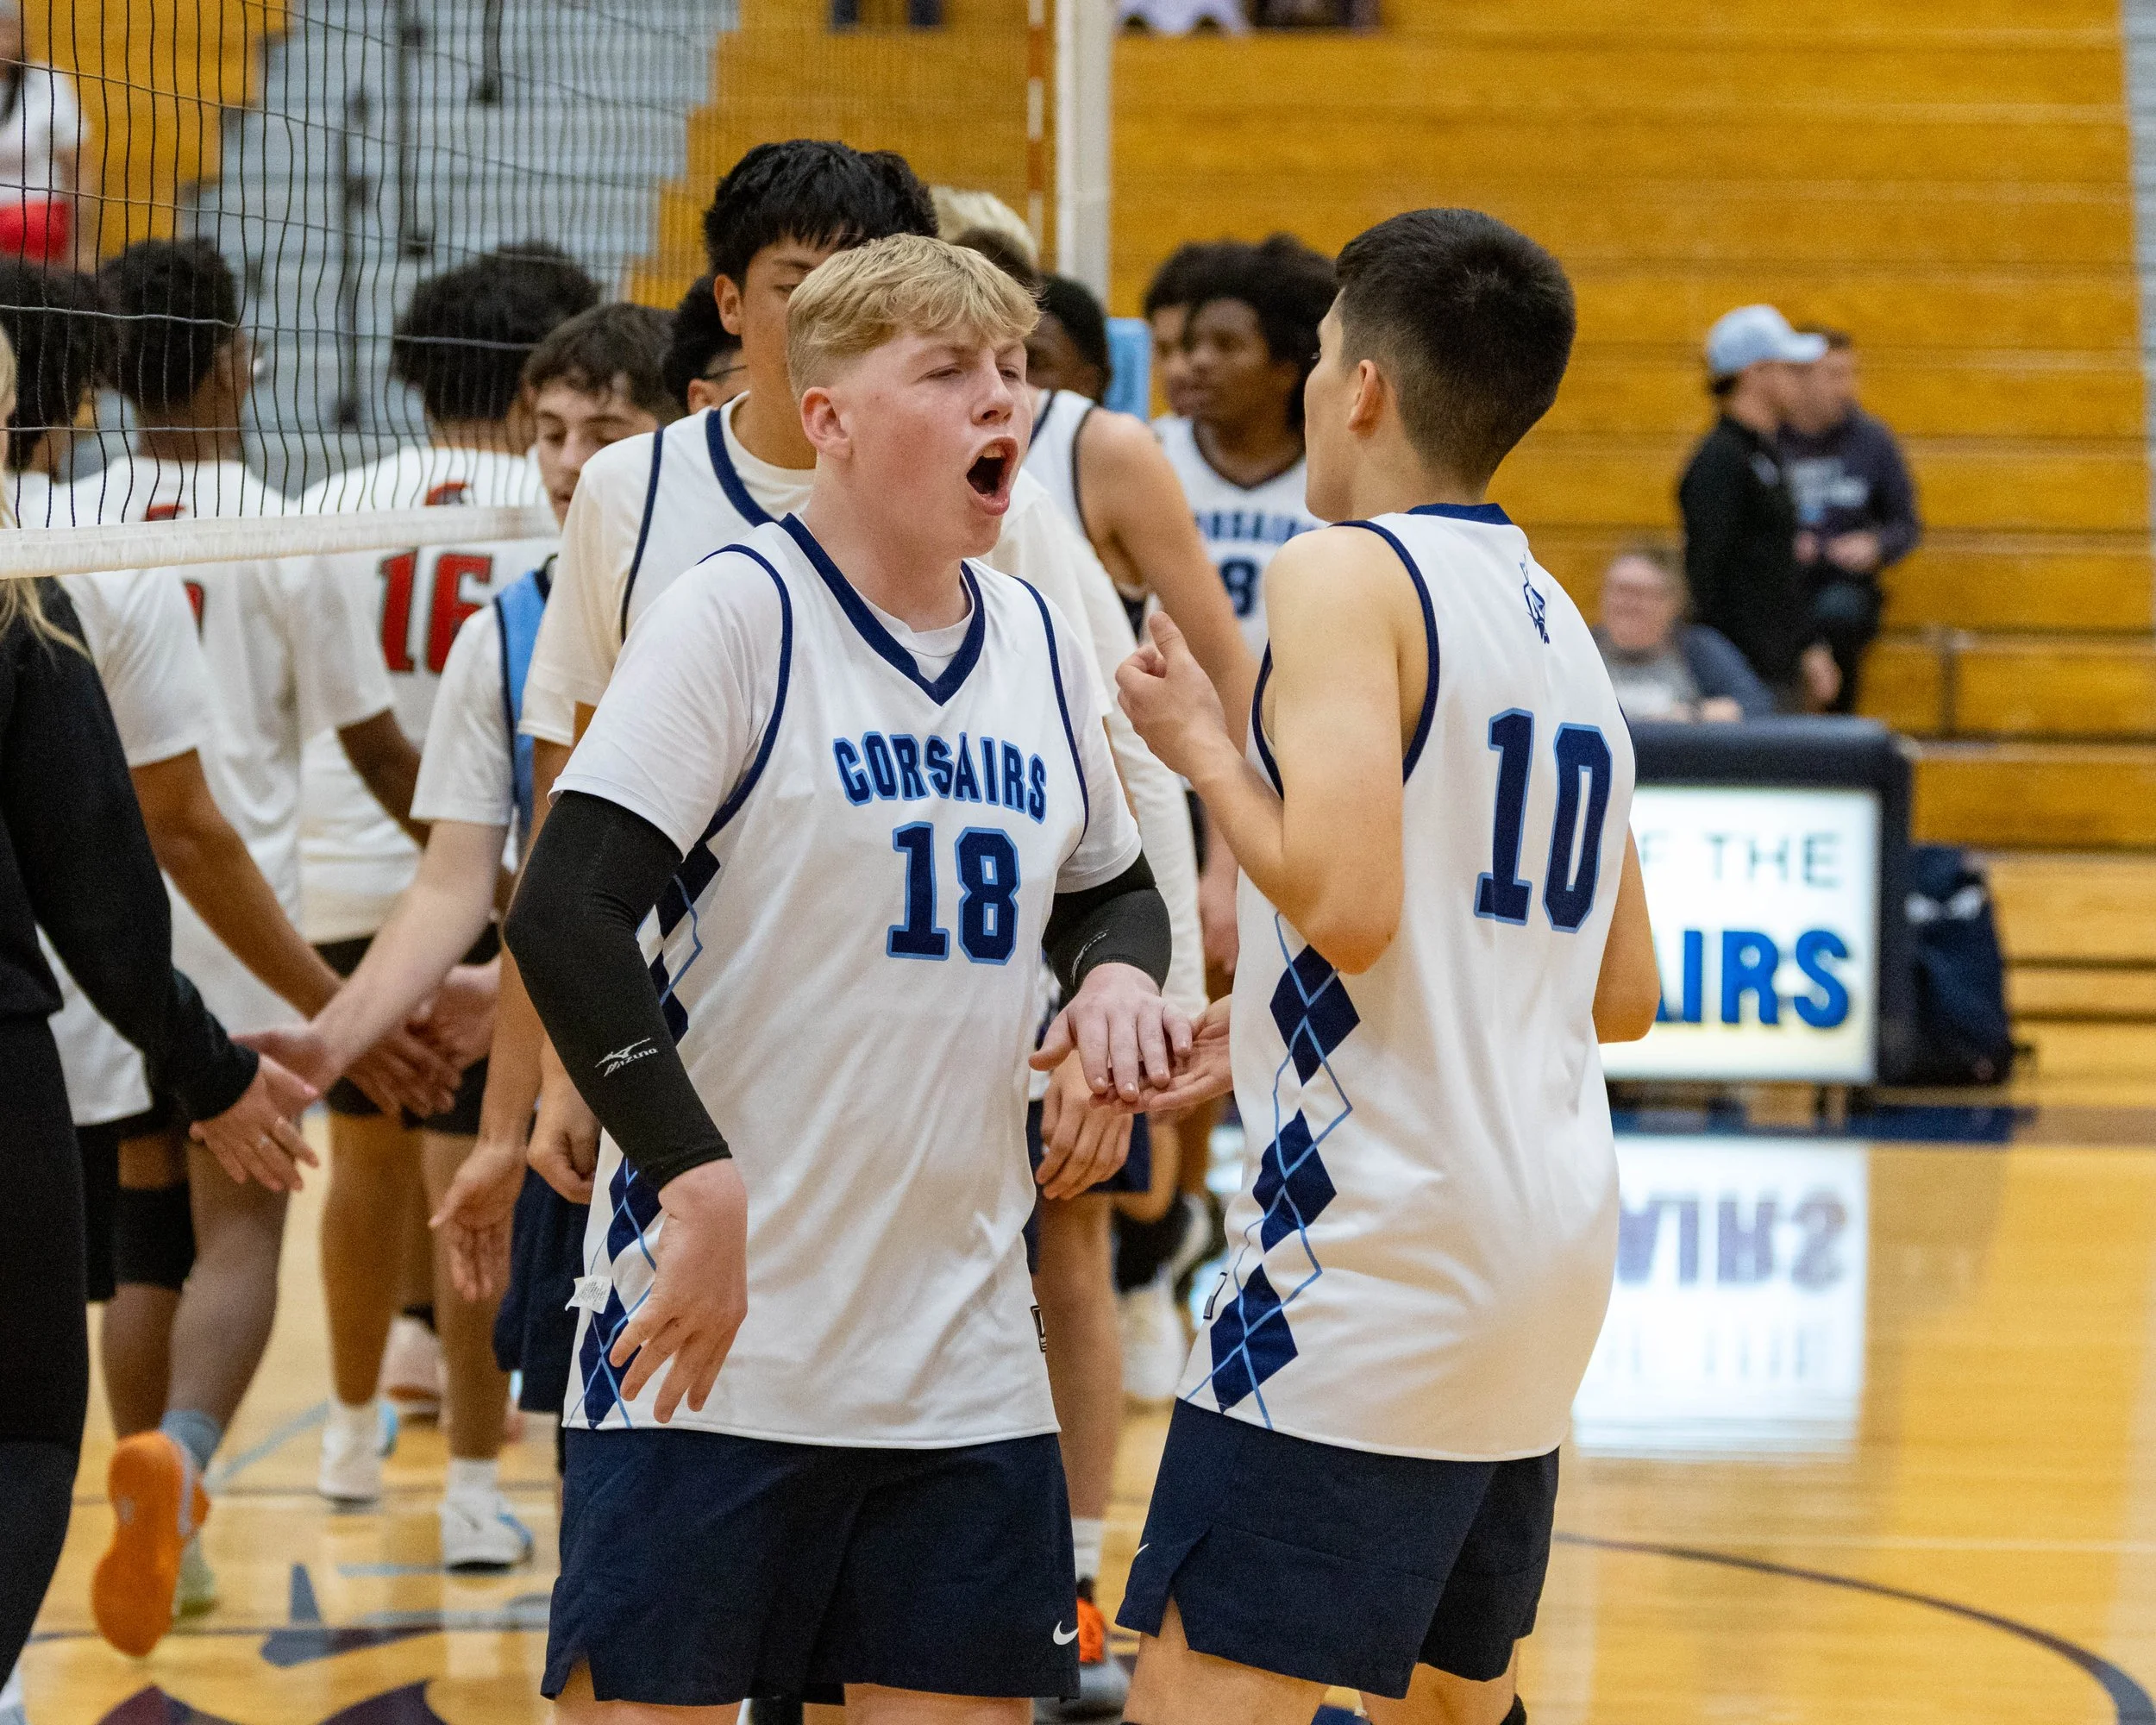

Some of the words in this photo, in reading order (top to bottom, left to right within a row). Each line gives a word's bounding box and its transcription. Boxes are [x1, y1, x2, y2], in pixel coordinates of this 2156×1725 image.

[832, 731, 1046, 825] CORSAIRS
[1474, 707, 1614, 934] 10
[886, 821, 1021, 966] 18
[1705, 830, 1844, 888] THE
